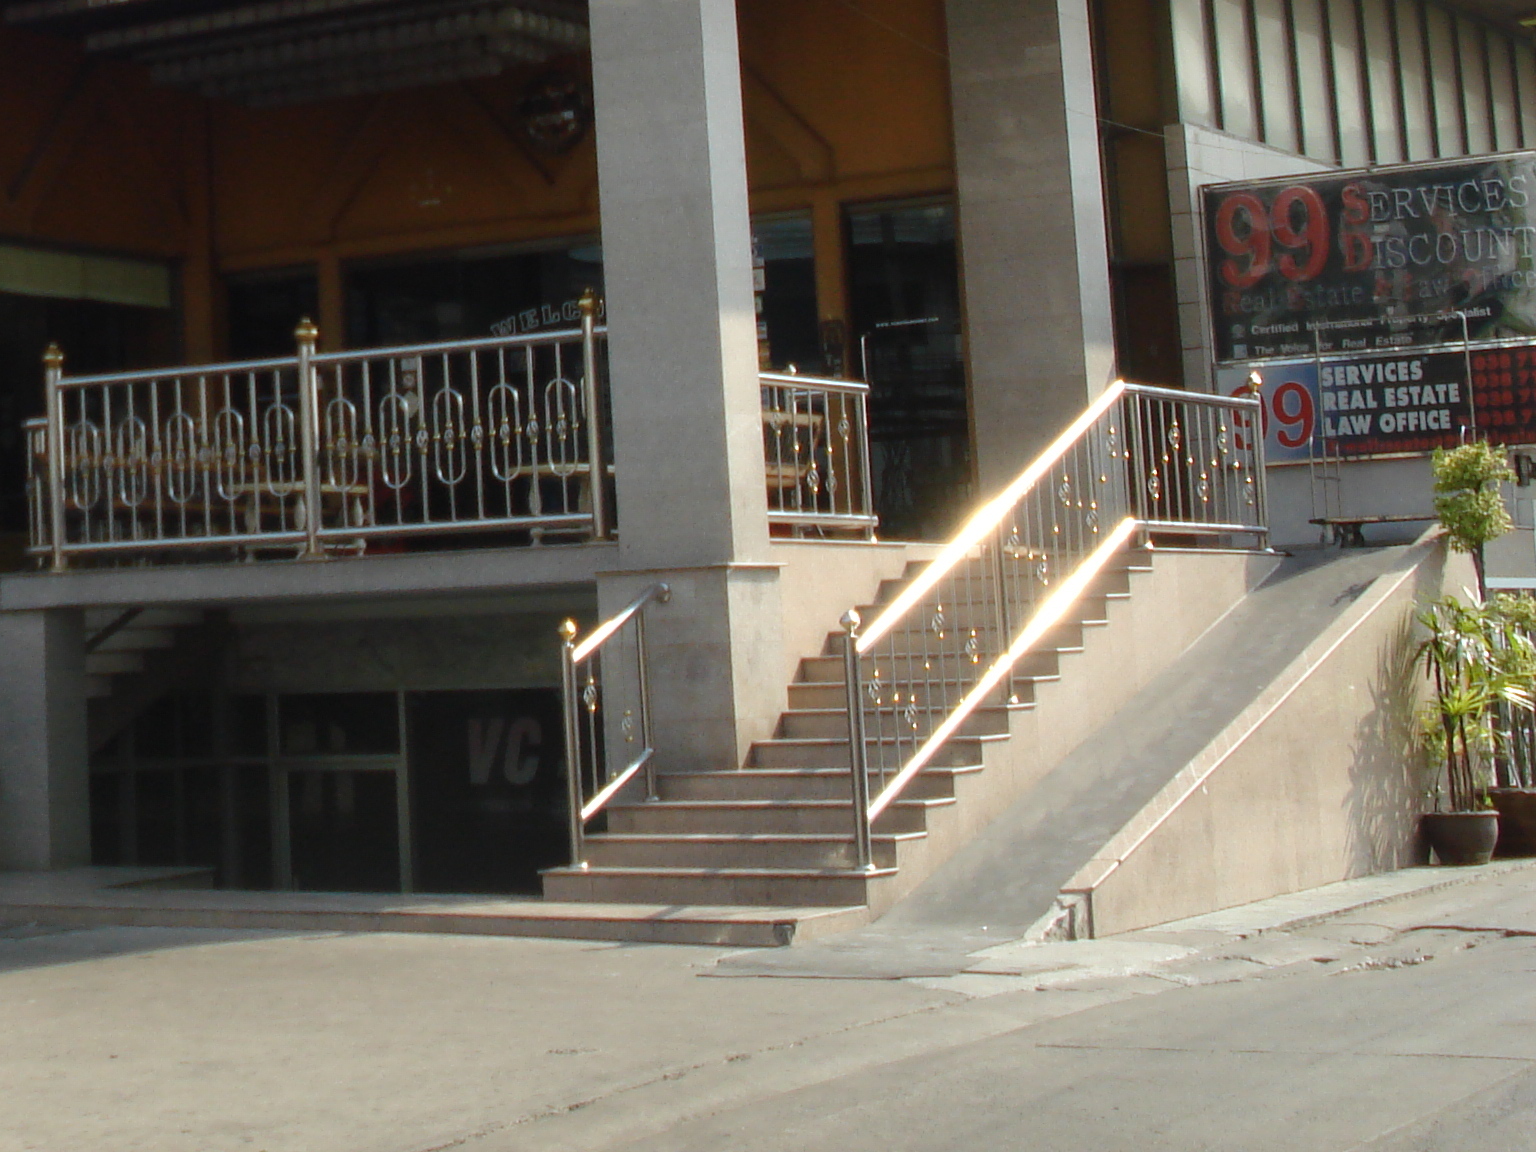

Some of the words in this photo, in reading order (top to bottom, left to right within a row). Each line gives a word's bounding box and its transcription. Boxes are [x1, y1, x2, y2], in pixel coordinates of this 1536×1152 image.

[1216, 185, 1330, 288] 99
[1340, 173, 1530, 225] SERVICES
[1340, 225, 1536, 273] DISCOUNT
[1322, 360, 1424, 387] SERVICES
[1323, 389, 1378, 411] REAL
[1384, 382, 1461, 408] ESTATE
[1325, 413, 1372, 436] LAW
[1379, 409, 1452, 434] OFFICE
[467, 716, 542, 785] VC
